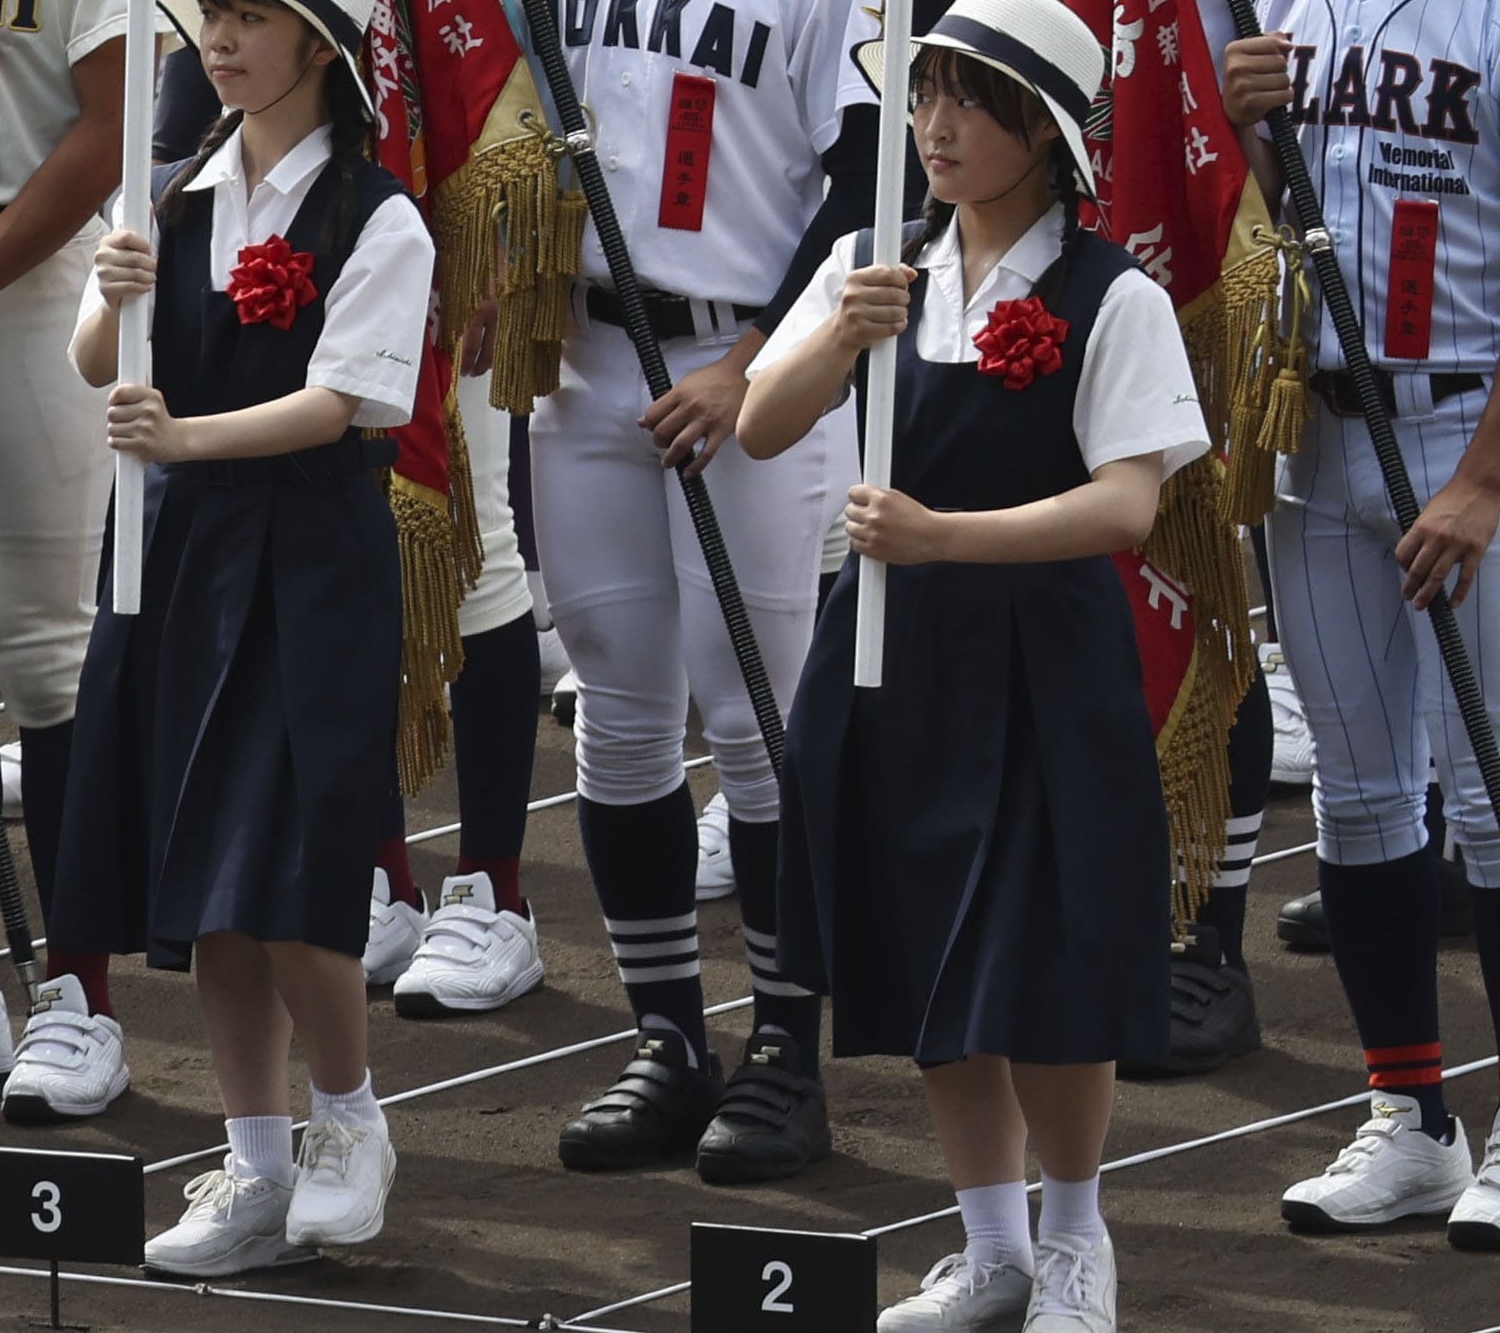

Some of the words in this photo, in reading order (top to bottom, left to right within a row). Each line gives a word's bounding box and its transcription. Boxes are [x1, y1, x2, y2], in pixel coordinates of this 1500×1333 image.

[1285, 42, 1481, 146] LARK
[31, 1180, 62, 1233] 3
[761, 1260, 794, 1313] 2
